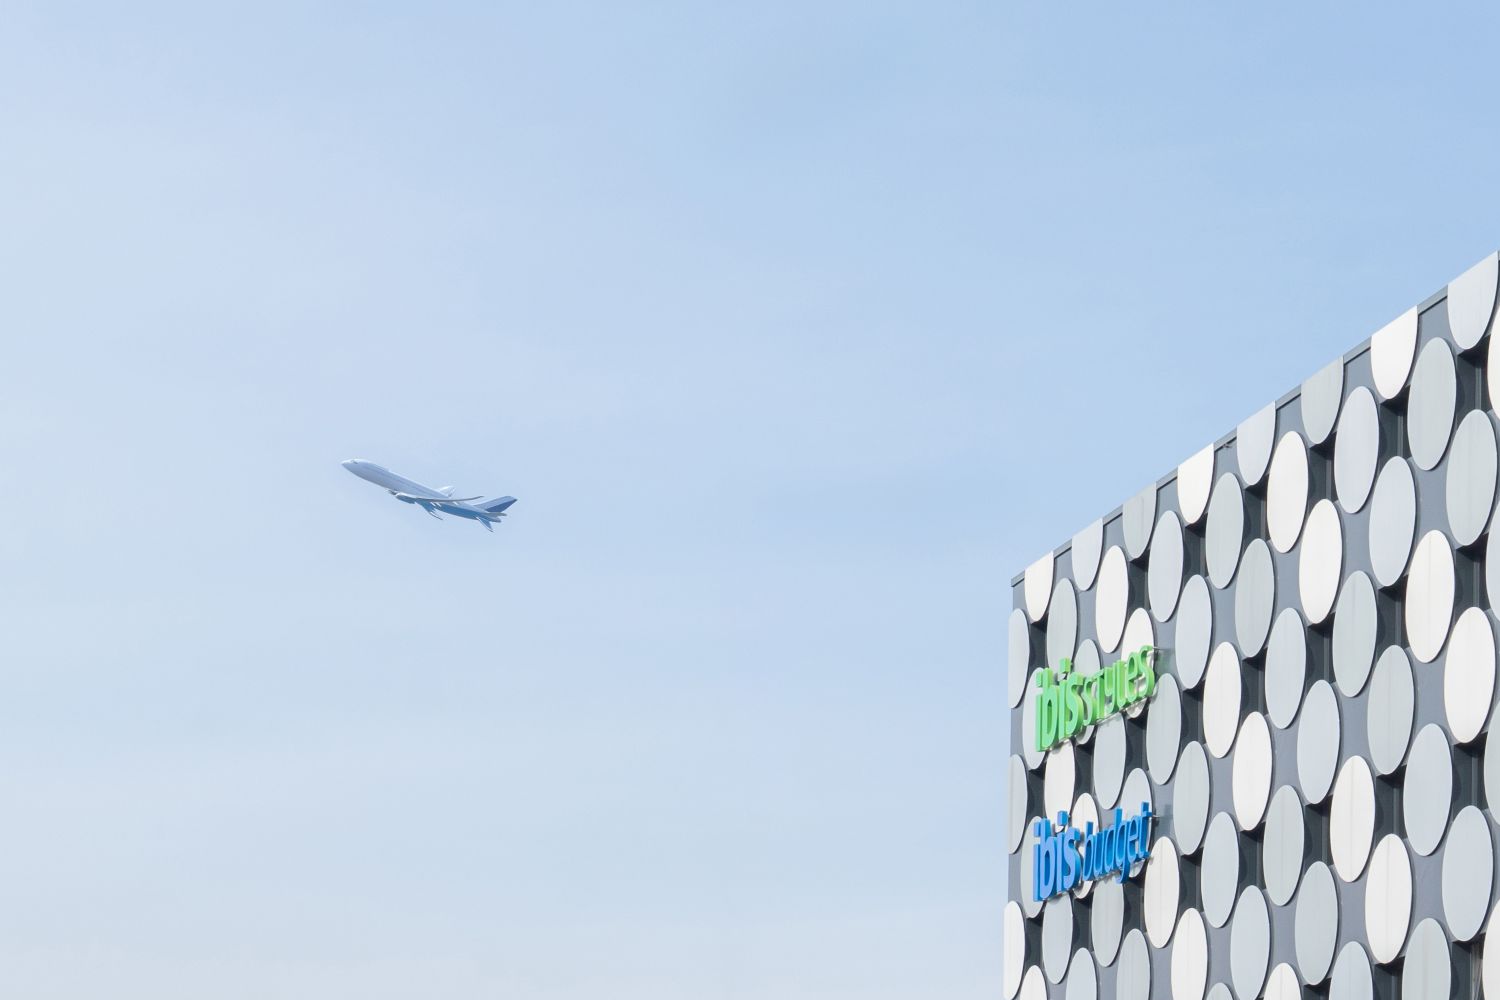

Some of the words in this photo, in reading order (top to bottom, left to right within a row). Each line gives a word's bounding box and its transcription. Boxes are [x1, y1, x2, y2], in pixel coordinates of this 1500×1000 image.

[1036, 657, 1083, 752] ibis
[1033, 810, 1081, 902] ibis
[1082, 801, 1152, 884] budget
